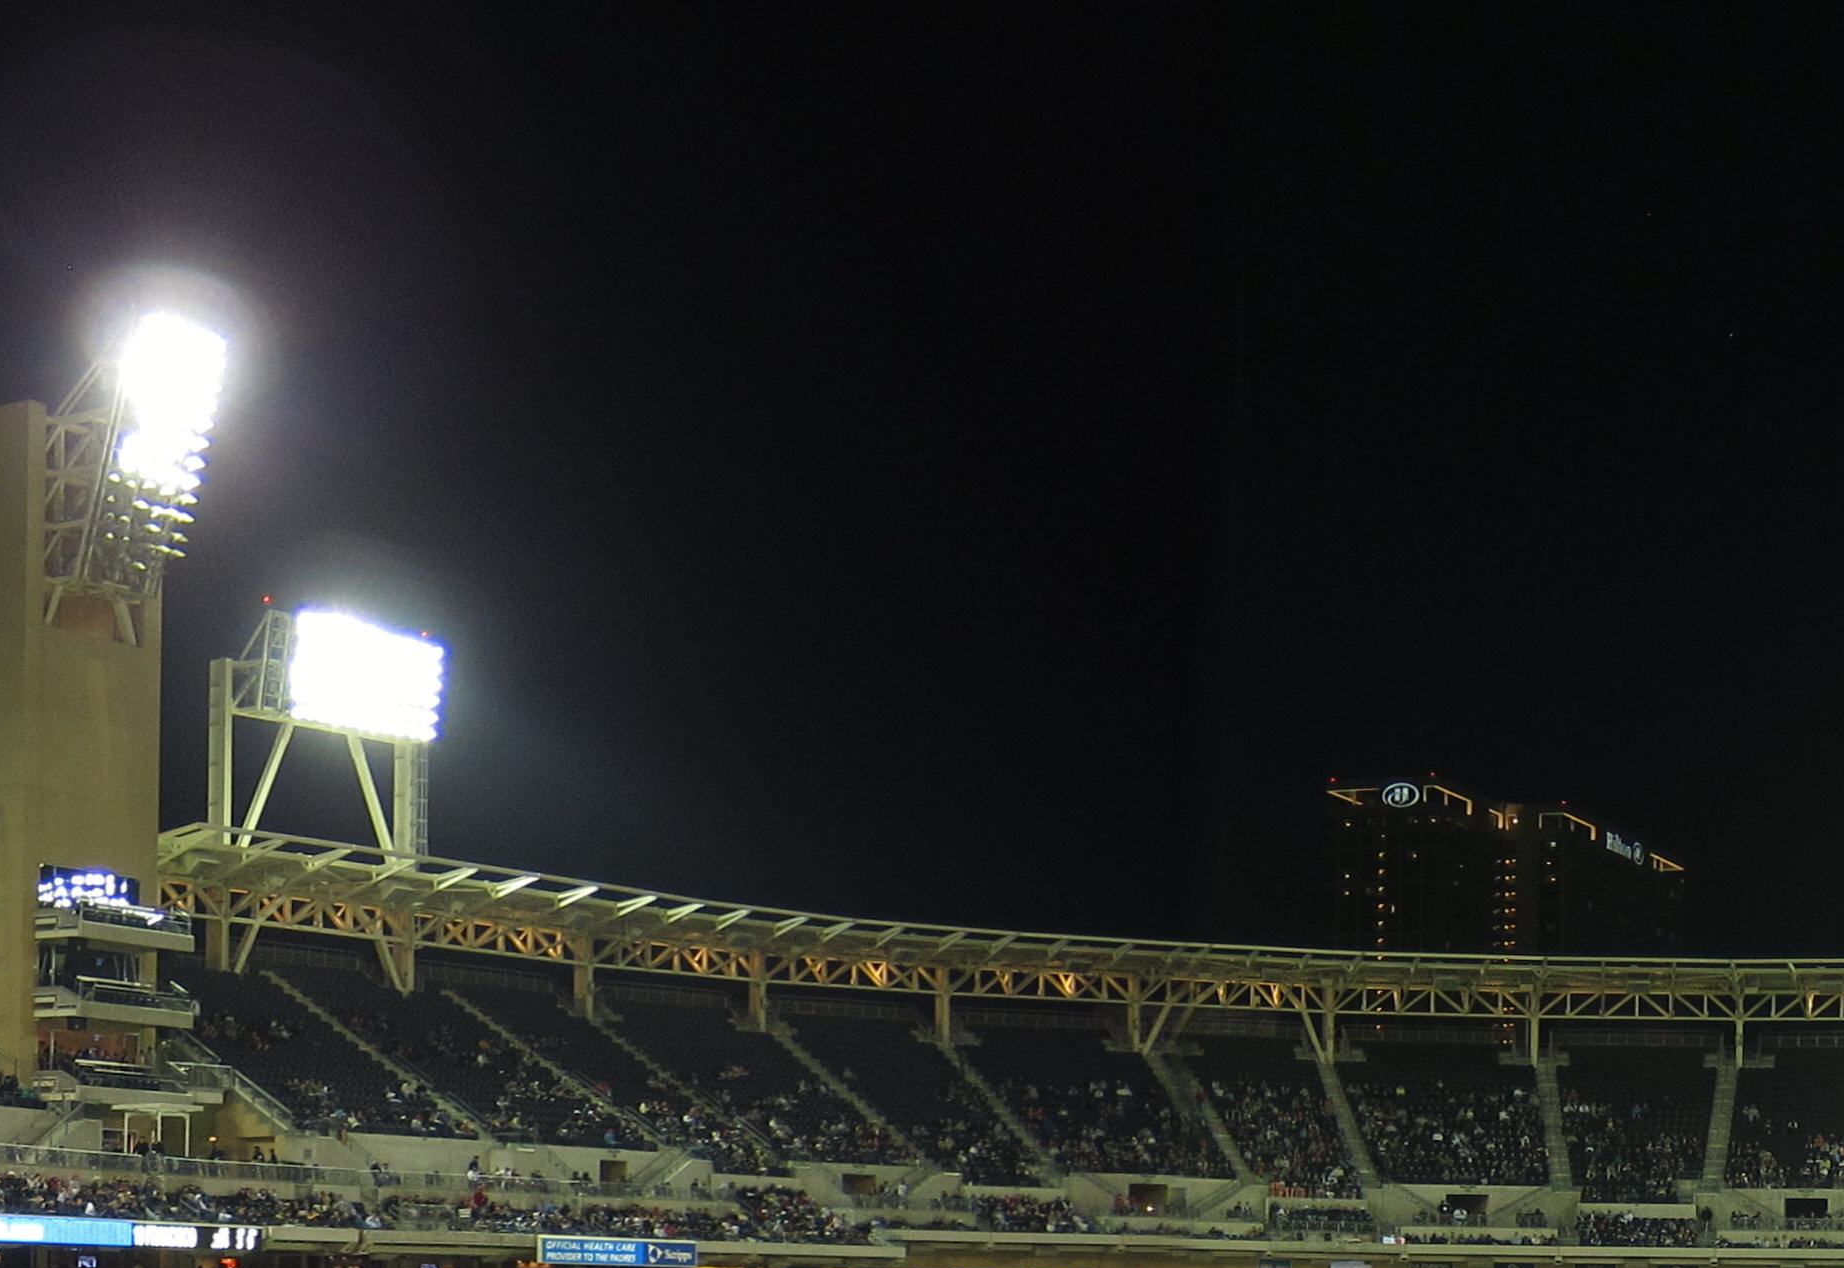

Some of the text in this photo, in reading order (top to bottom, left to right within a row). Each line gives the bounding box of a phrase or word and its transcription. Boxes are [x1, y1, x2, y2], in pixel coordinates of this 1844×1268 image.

[545, 1240, 637, 1252] OFFICIAL HEALTH CARE
[546, 1251, 582, 1263] PROVIDER
[609, 1252, 636, 1263] PADRES
[664, 1248, 693, 1263] Scripps
